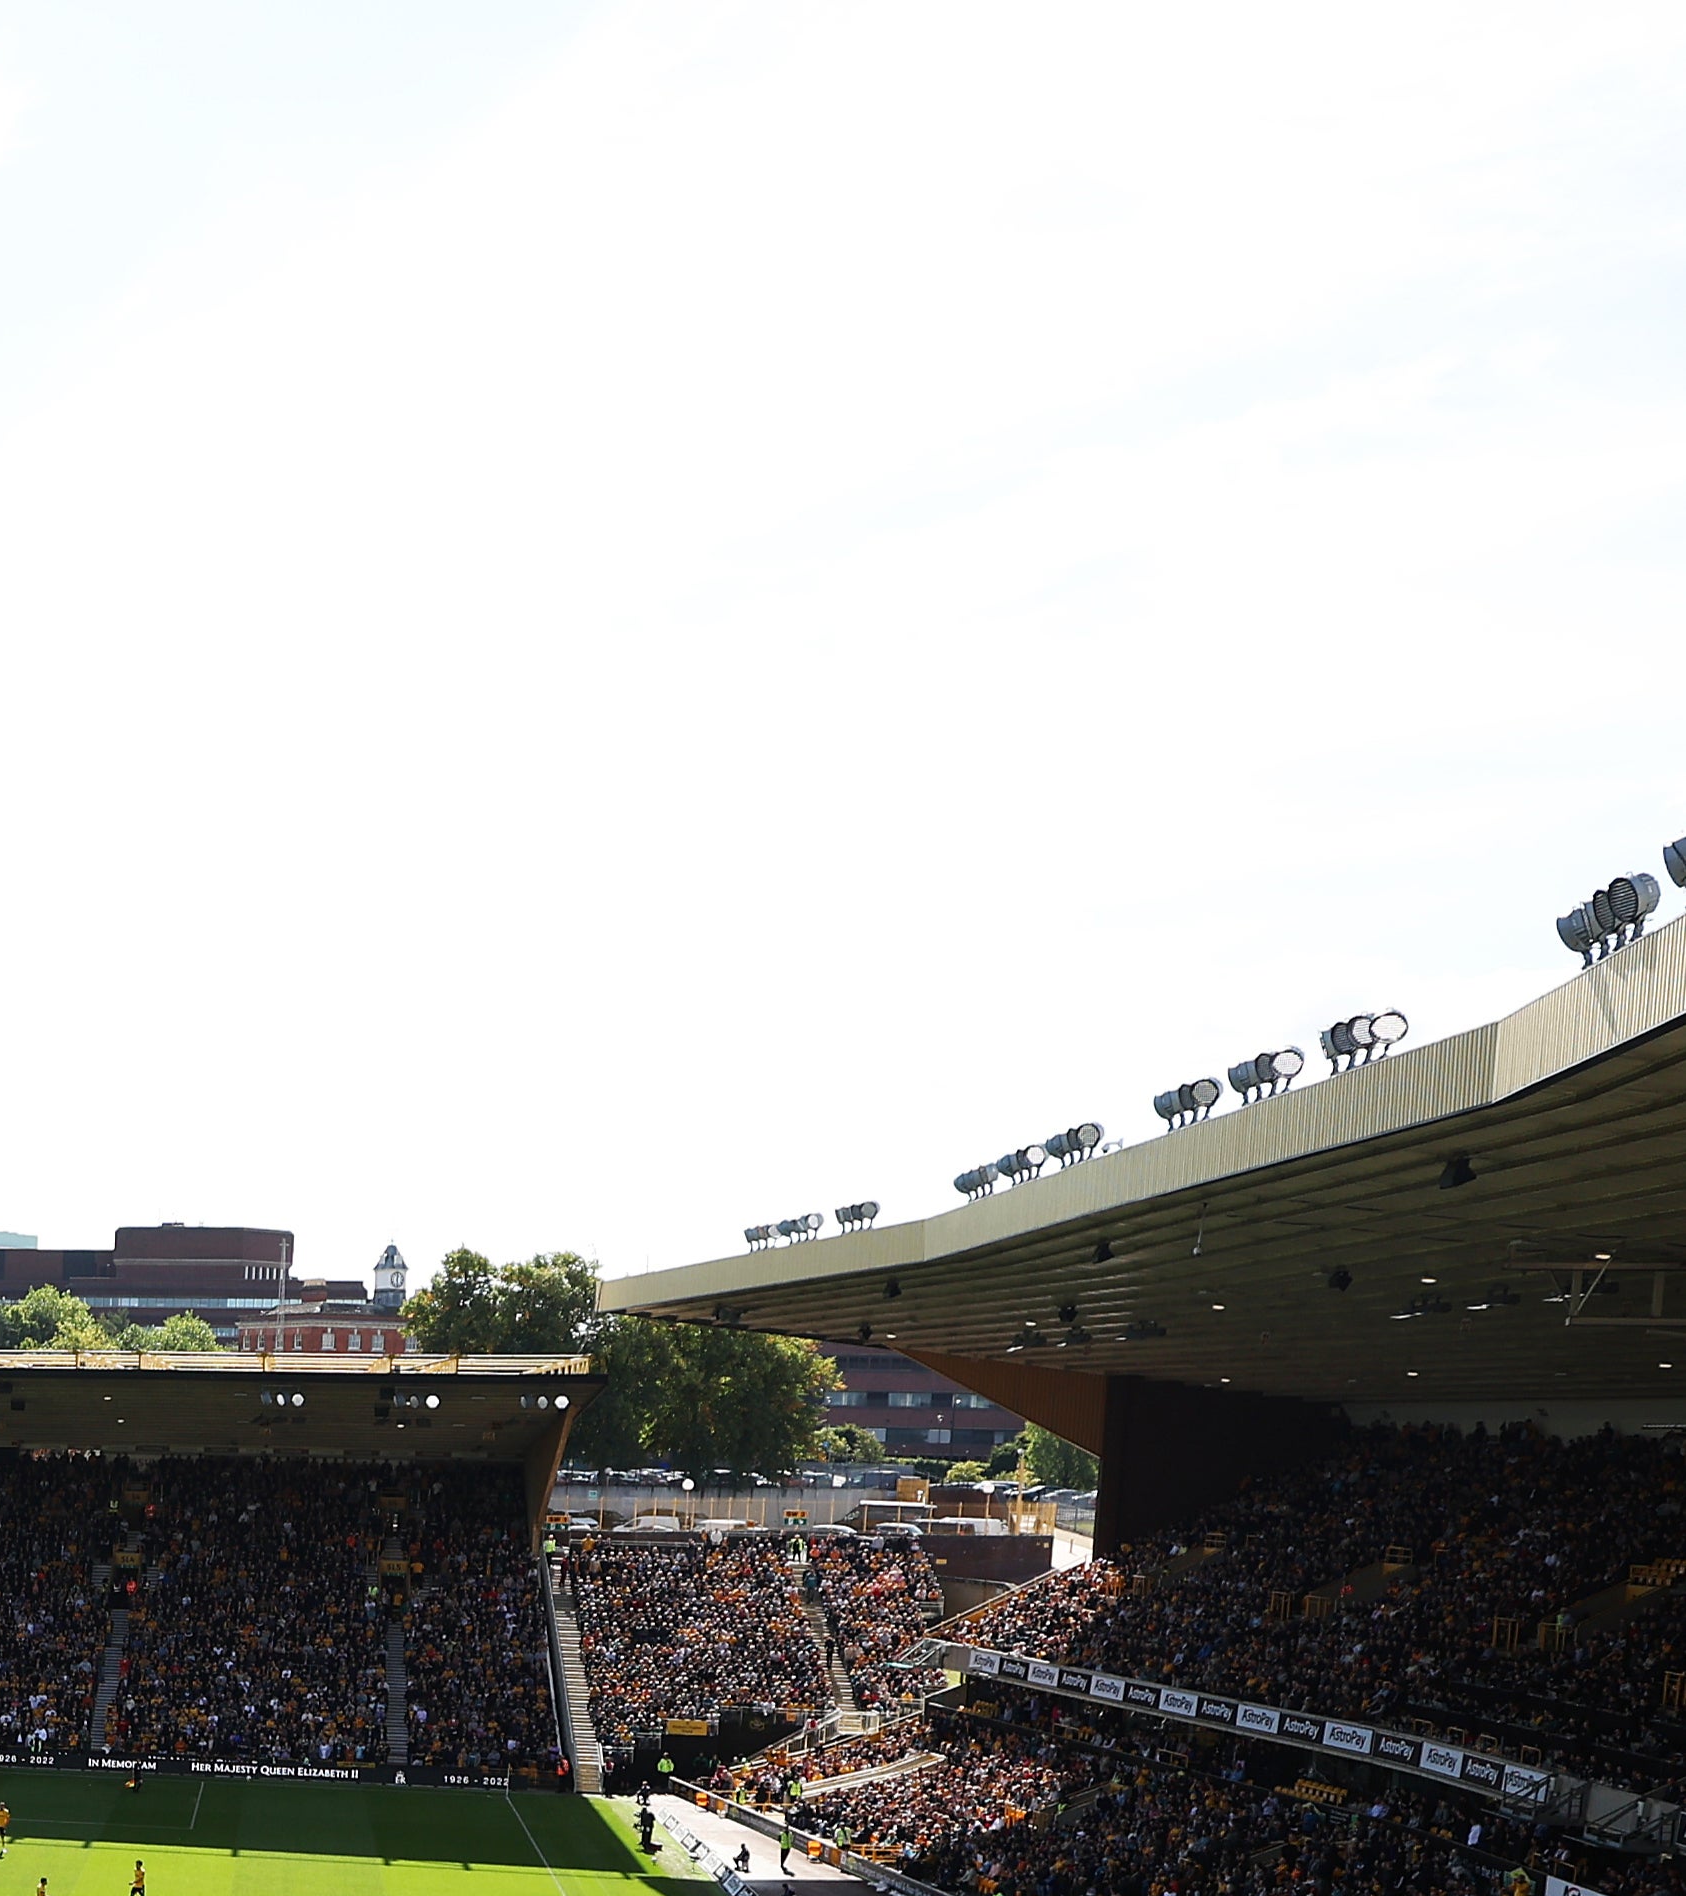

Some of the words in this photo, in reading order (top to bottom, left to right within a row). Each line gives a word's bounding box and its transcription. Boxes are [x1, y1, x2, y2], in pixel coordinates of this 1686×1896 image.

[1094, 1678, 1121, 1697] AstroPay
[1241, 1708, 1275, 1731] AstroPay
[1282, 1717, 1320, 1741] AstroPay
[1329, 1726, 1367, 1750] AstroPay
[1379, 1736, 1415, 1760] AstroPay
[30, 1755, 55, 1765] 2022
[190, 1761, 212, 1773] HER
[213, 1763, 258, 1776] MAJESTY
[260, 1765, 295, 1778] QUEEN
[297, 1767, 349, 1779] ELIZABETH
[1426, 1747, 1458, 1771] AstroPay
[1465, 1758, 1499, 1783] AstroPay
